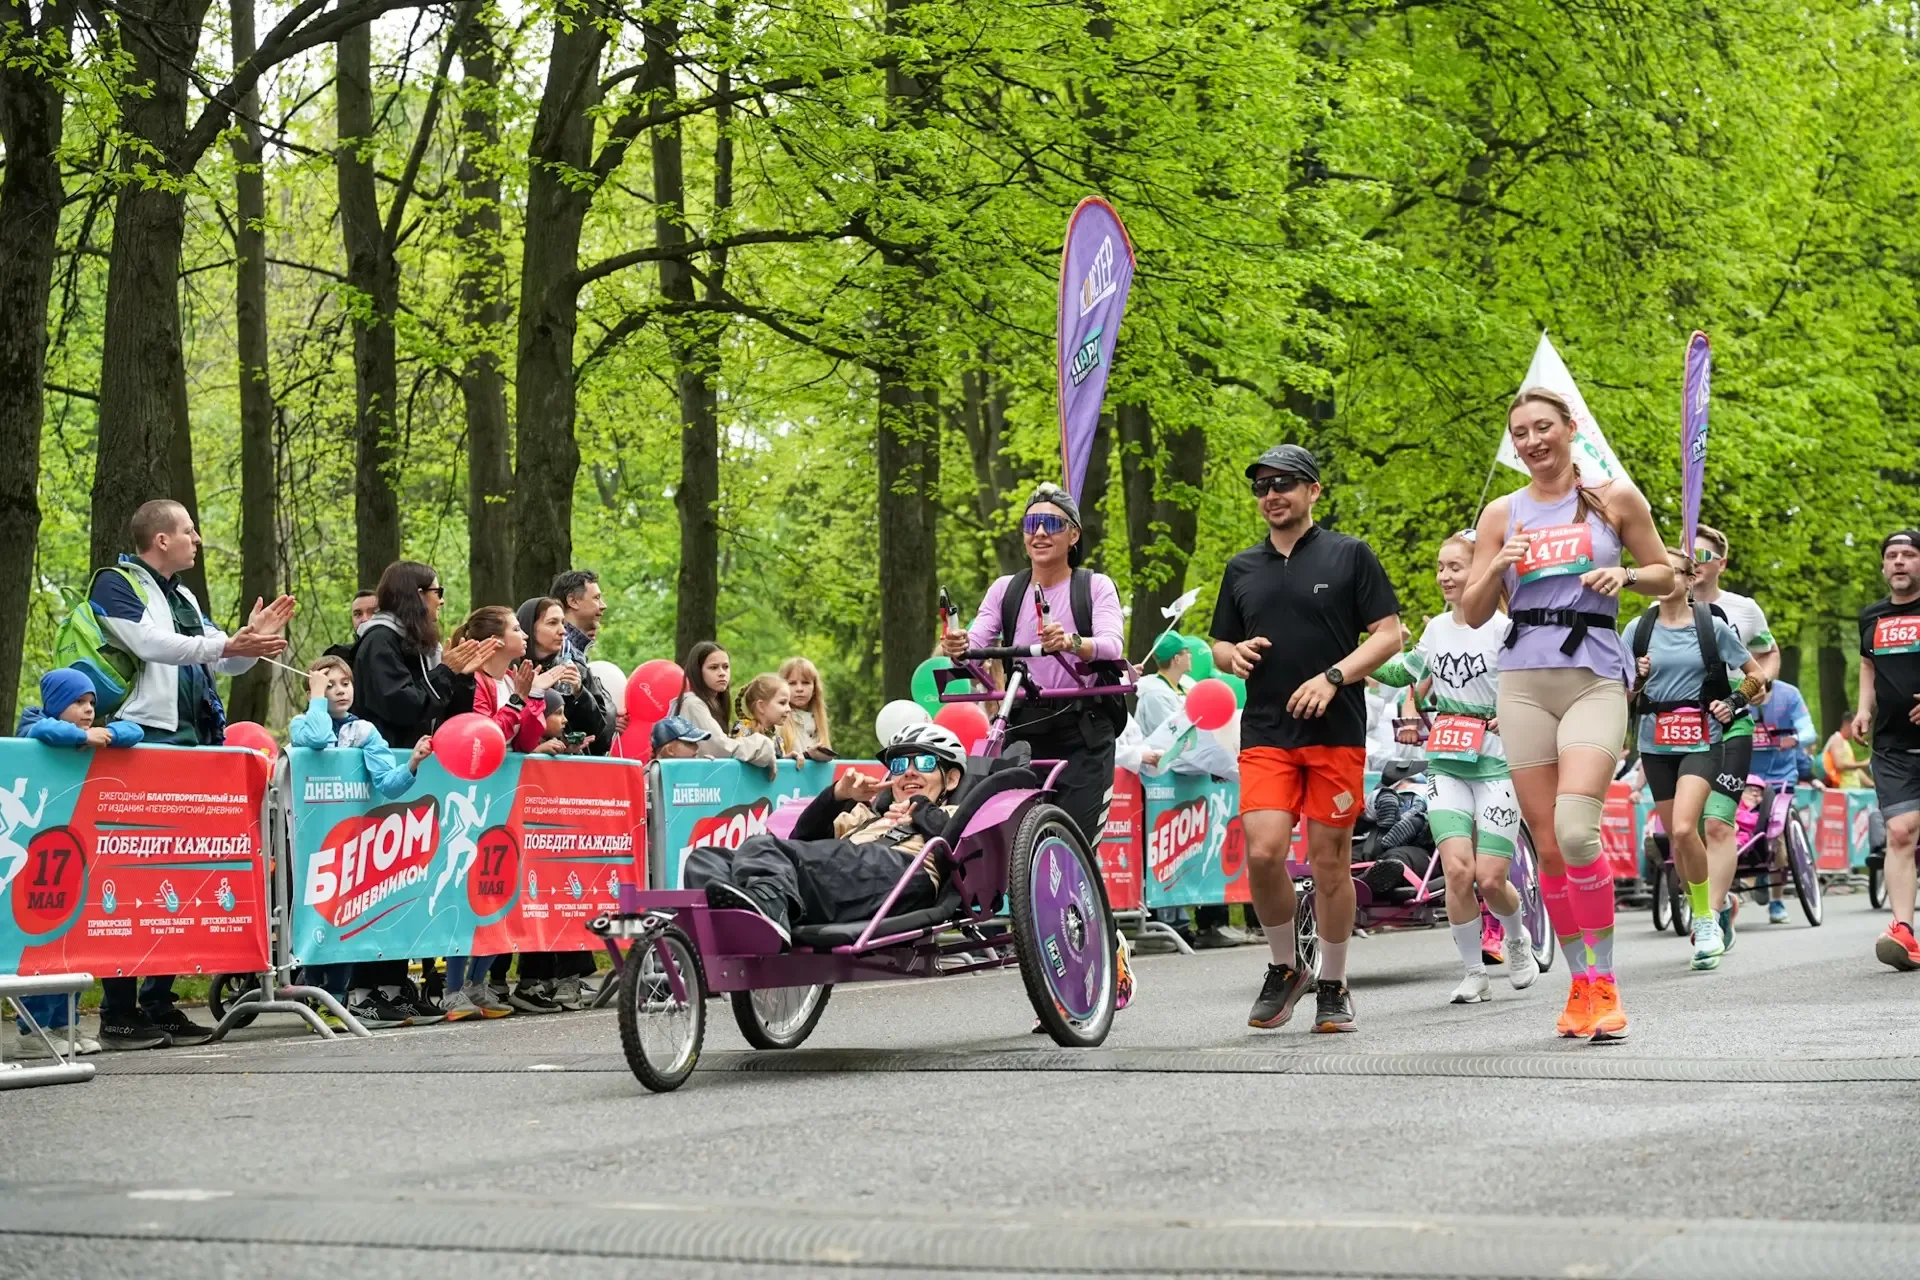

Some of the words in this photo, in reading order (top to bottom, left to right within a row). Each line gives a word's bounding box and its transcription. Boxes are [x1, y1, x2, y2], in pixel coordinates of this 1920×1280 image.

[1524, 538, 1580, 565] 1477
[1880, 626, 1918, 642] 1562
[1434, 729, 1473, 747] 1515
[1661, 725, 1702, 740] 1533
[99, 791, 146, 801] ЕЖЕГОДНЫЙ
[146, 792, 228, 803] БЛАГОТВОРИТЕЛЬНЫЙ
[304, 782, 370, 800] ДНЕВНИК
[672, 788, 721, 803] ДНЕВНИК
[97, 803, 107, 812] ОТ
[108, 804, 144, 813] ИЗДАНИЯ
[145, 804, 205, 814] «ПЕТЕРБУРГСКИЙ
[205, 806, 243, 815] ДНЕВНИК»
[1147, 801, 1206, 867] БЕГОМ
[96, 836, 173, 858] ПОБЕДИТ
[173, 833, 252, 858] КАЖДЫЙ!
[524, 834, 577, 852] ПОБЕДИТ
[577, 833, 633, 853] КАЖДЫЙ!
[304, 802, 435, 905] БЕГОМ
[480, 845, 509, 876] 17
[33, 849, 71, 886] 17
[341, 863, 429, 924] ДНЕВНИКОМ
[478, 881, 505, 895] МАЯ
[27, 892, 66, 909] МАЯ
[88, 918, 132, 928] ПРИМОРСКИЙ
[88, 928, 105, 936] ПАРК
[106, 928, 132, 937] ПОБЕДЫ
[104, 1025, 135, 1034] ABRICOT
